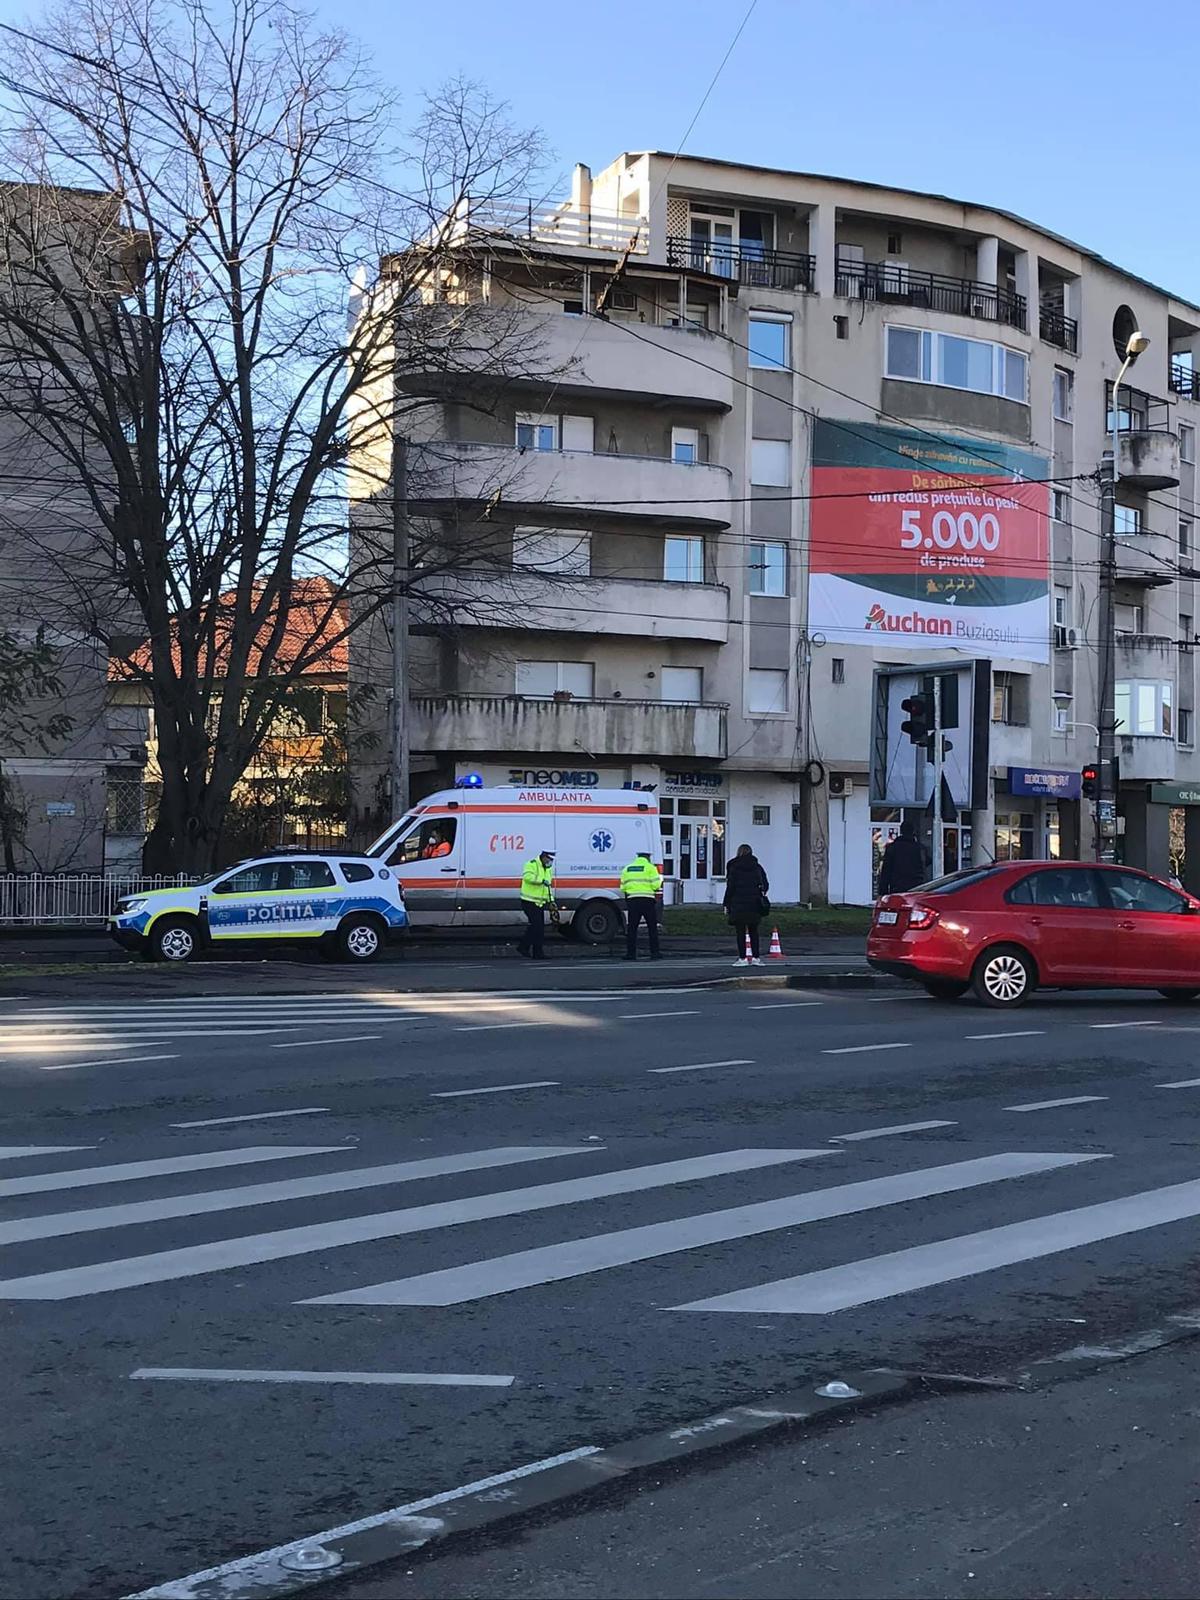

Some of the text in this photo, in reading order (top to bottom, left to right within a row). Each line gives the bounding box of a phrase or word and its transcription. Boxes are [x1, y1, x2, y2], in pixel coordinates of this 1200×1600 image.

[912, 474, 929, 489] De
[894, 488, 928, 504] redus
[983, 494, 994, 507] la
[900, 509, 1000, 551] 5.000
[920, 552, 986, 570] de produse
[864, 603, 952, 635] Auchan
[519, 792, 592, 802] AMBULANTA
[501, 835, 525, 850] 112
